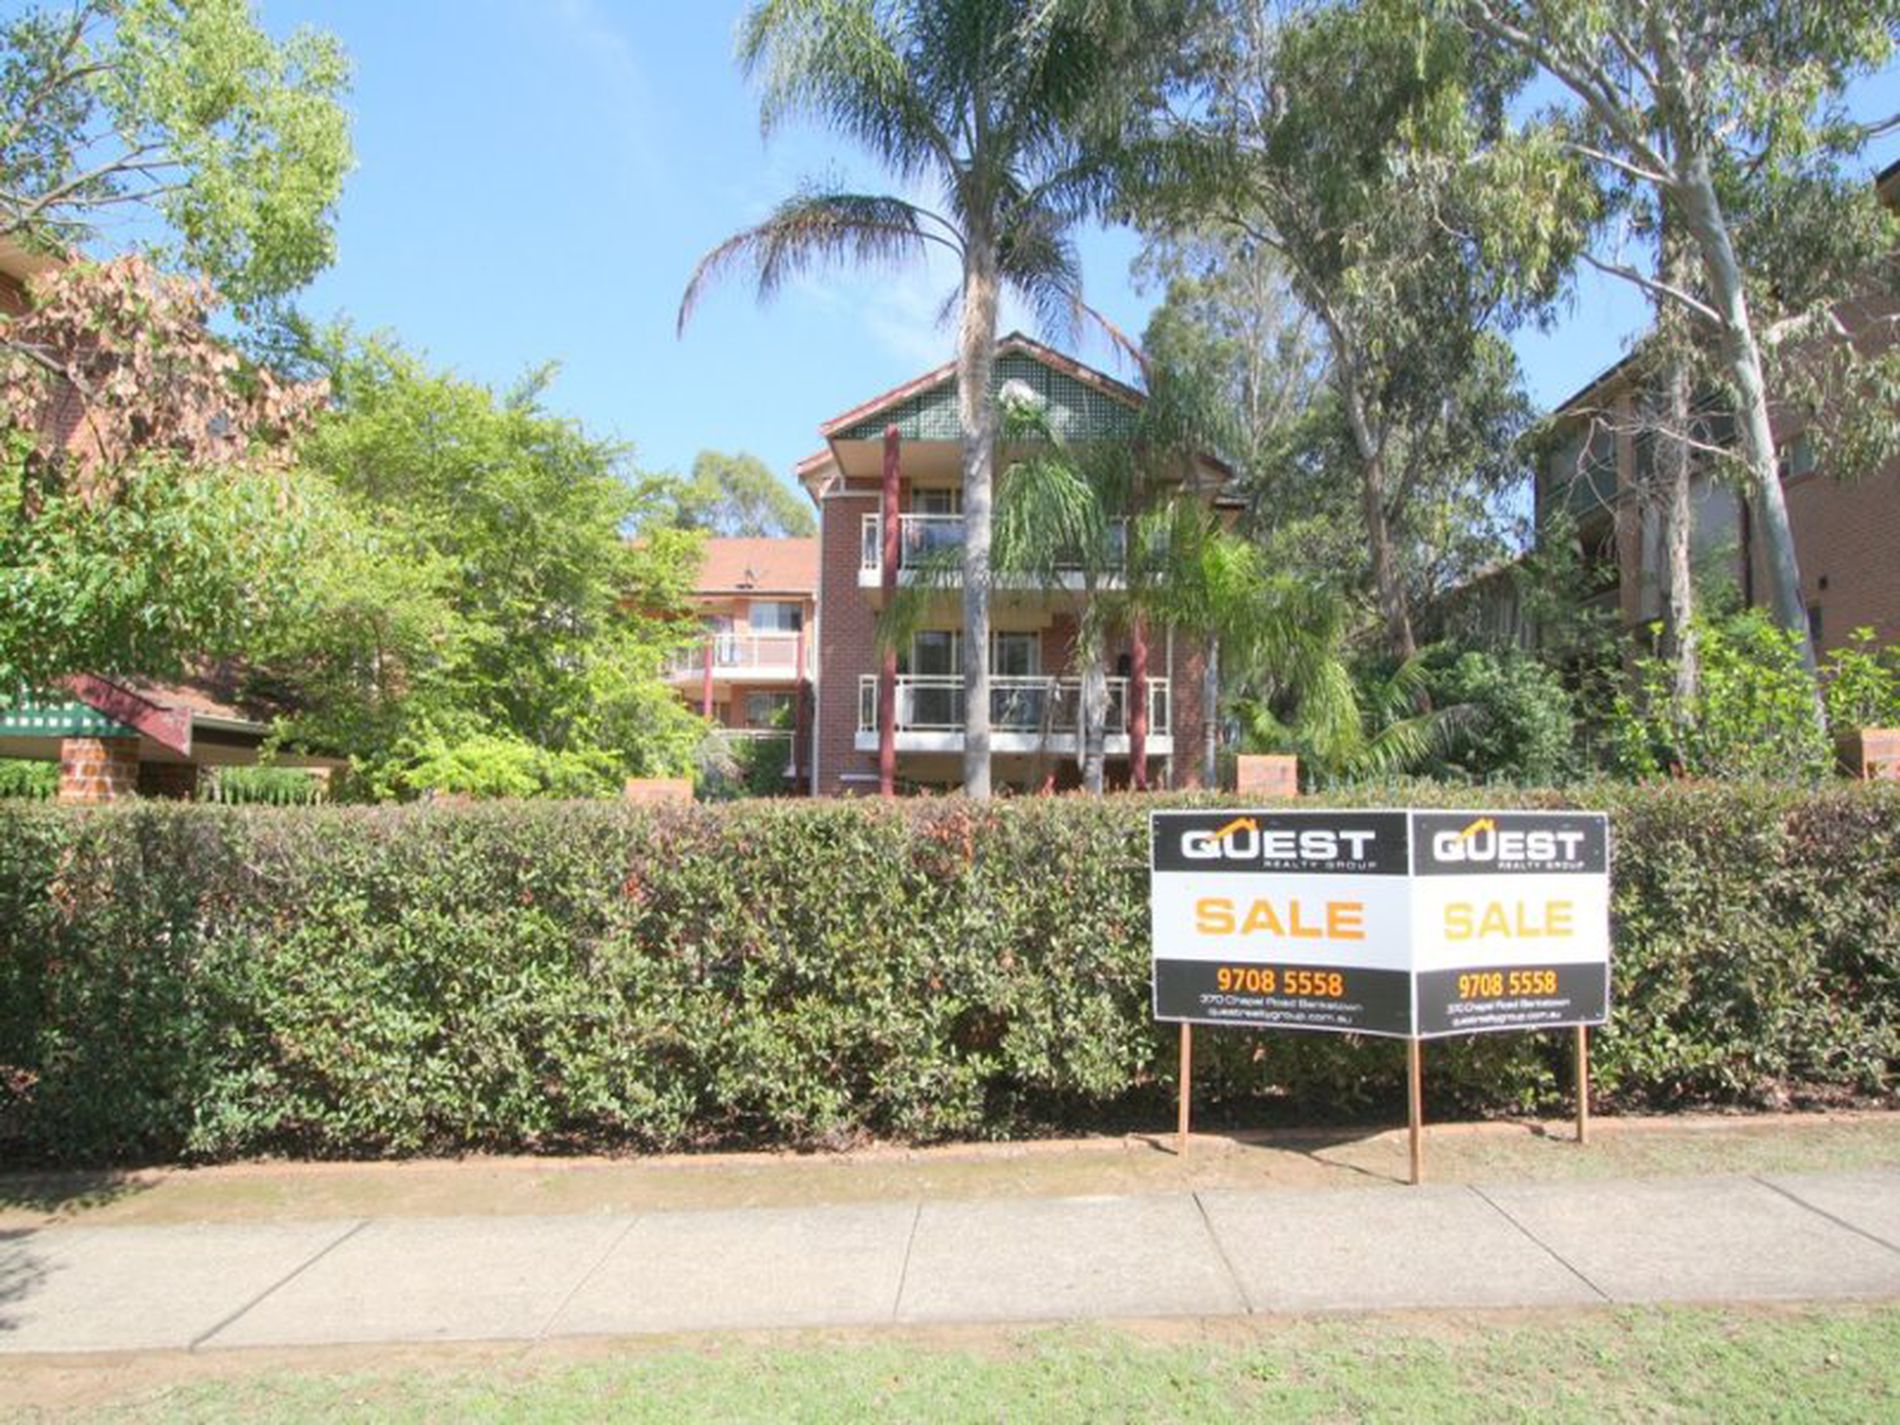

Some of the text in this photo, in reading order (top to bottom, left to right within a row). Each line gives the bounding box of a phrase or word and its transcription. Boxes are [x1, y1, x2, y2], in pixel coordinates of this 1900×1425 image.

[1263, 860, 1378, 870] REALTY GROUP
[1196, 898, 1366, 939] SALE
[1444, 900, 1574, 940] SALE
[1217, 968, 1344, 997] 9708 5558
[1459, 970, 1558, 999] 9708 5558
